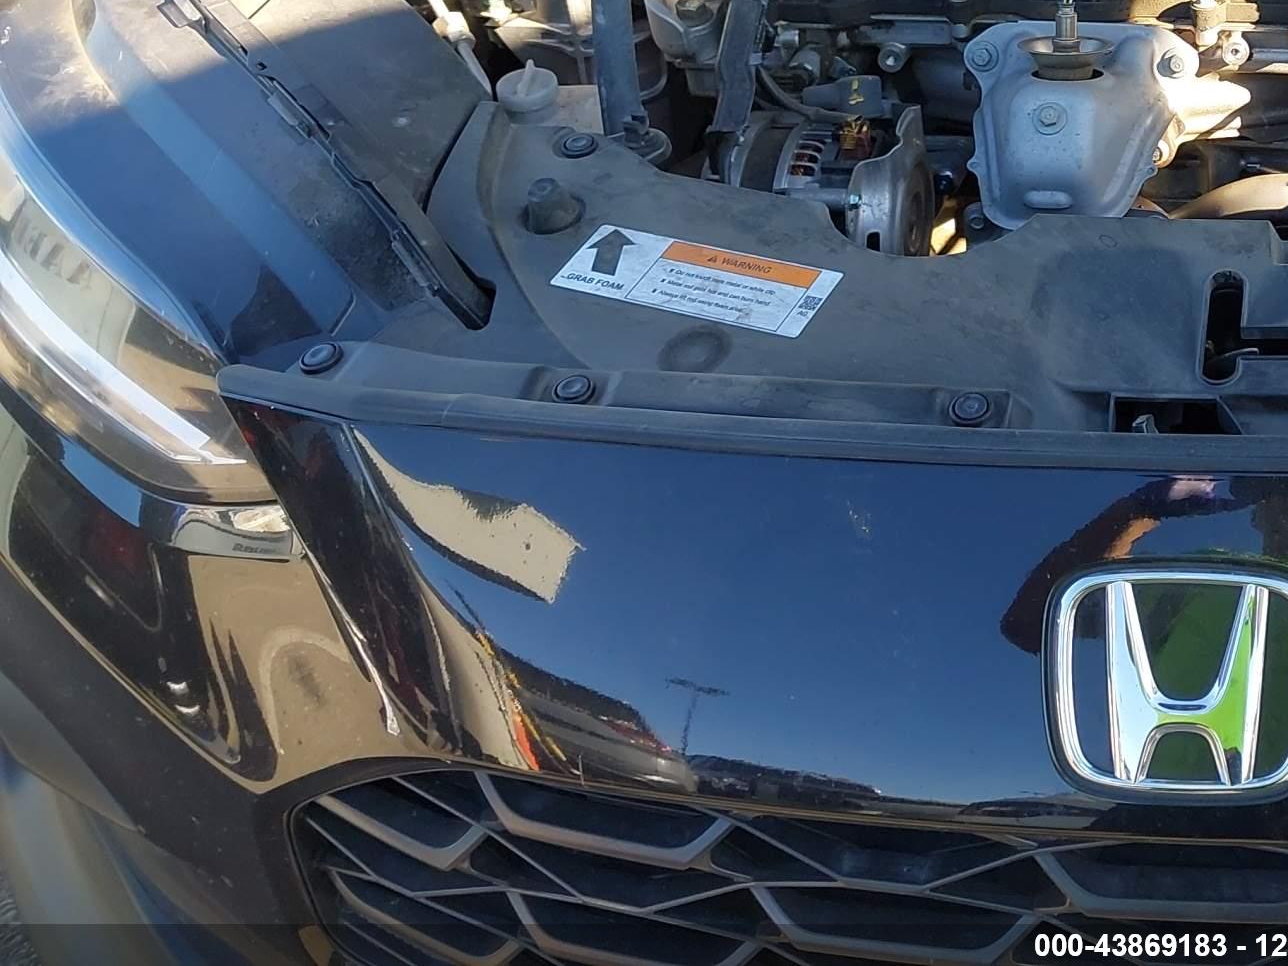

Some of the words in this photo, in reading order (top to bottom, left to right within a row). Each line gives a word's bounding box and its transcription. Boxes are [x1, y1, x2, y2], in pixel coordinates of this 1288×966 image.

[722, 257, 772, 274] WARNING
[566, 273, 594, 283] GRAB
[595, 278, 625, 290] FOAM
